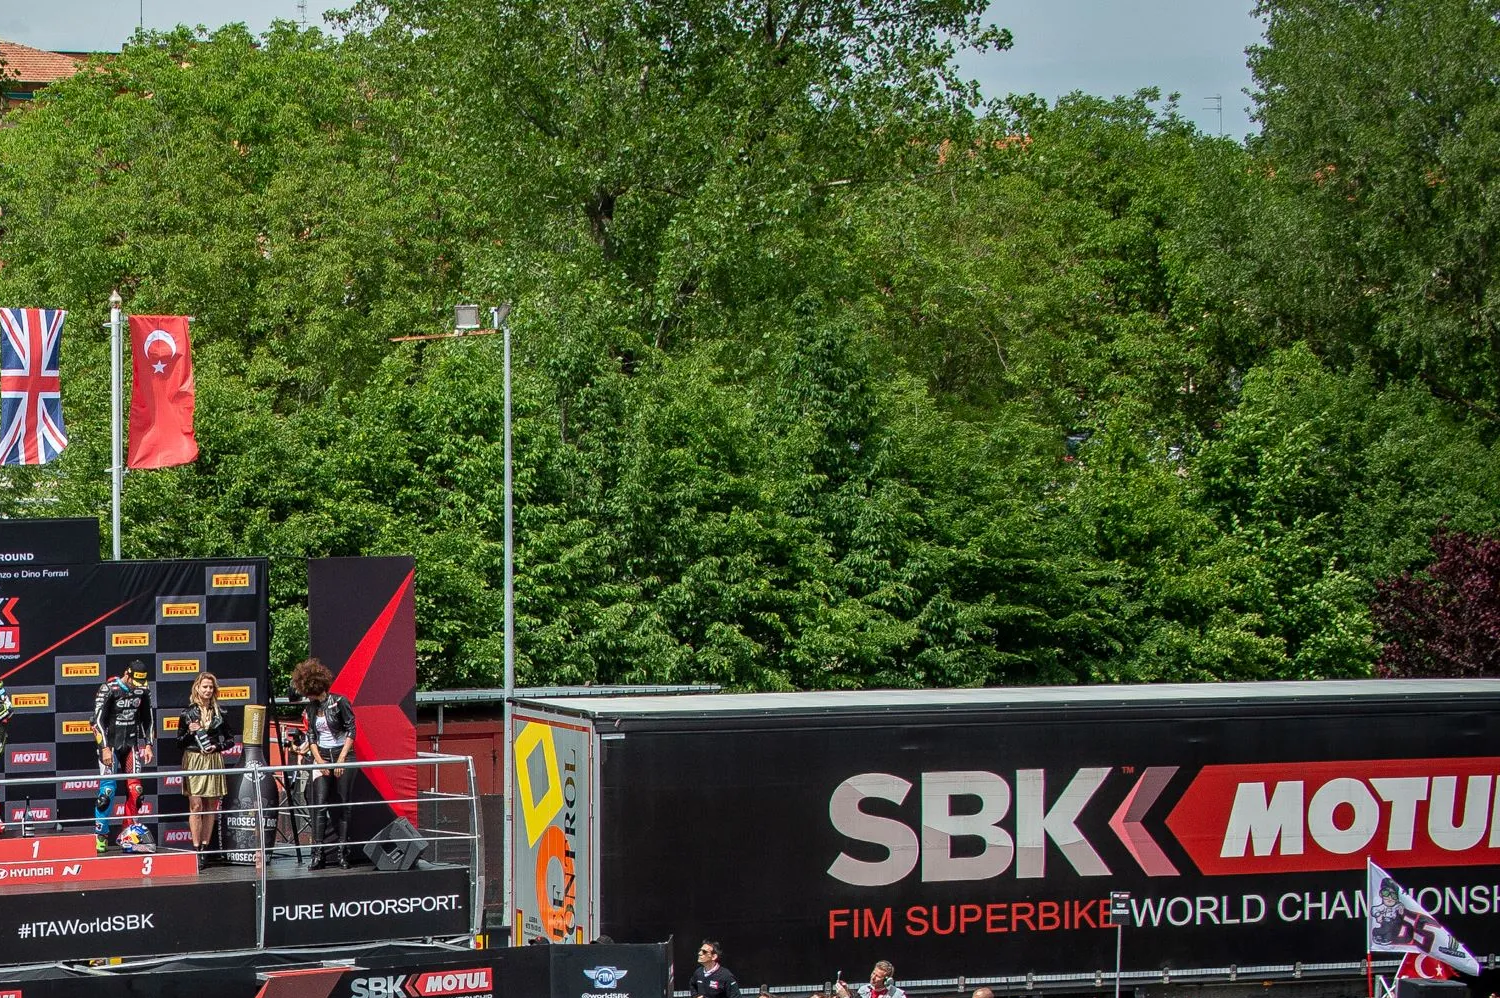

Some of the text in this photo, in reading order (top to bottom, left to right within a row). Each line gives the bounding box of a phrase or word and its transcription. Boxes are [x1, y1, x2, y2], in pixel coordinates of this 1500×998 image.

[21, 570, 41, 578] Dino
[42, 569, 69, 578] Ferrari
[215, 576, 247, 586] PIRELLI
[165, 606, 197, 615] PIRELLI
[115, 636, 147, 645] PIRELLI
[216, 632, 247, 642] PIRELLI
[65, 665, 98, 675] PIRELLI
[165, 662, 197, 672] PIRELLI
[14, 696, 47, 705] PIRELLI
[13, 752, 48, 763] MOTUL
[64, 779, 99, 789] MOTUL
[14, 810, 49, 820] MTUL
[1220, 774, 1500, 858] MOTU
[826, 766, 1135, 887] SBK TM
[32, 840, 40, 858] 1
[141, 857, 153, 875] 3
[10, 866, 53, 878] HYUNDAI
[272, 894, 463, 922] PURE MOTORSPORT.
[829, 906, 893, 940] FIM
[905, 898, 1119, 937] SUPERBIKE
[1130, 892, 1265, 928] WORLD
[18, 913, 155, 939] #ITAWorldSBK
[425, 971, 489, 994] MOTUL
